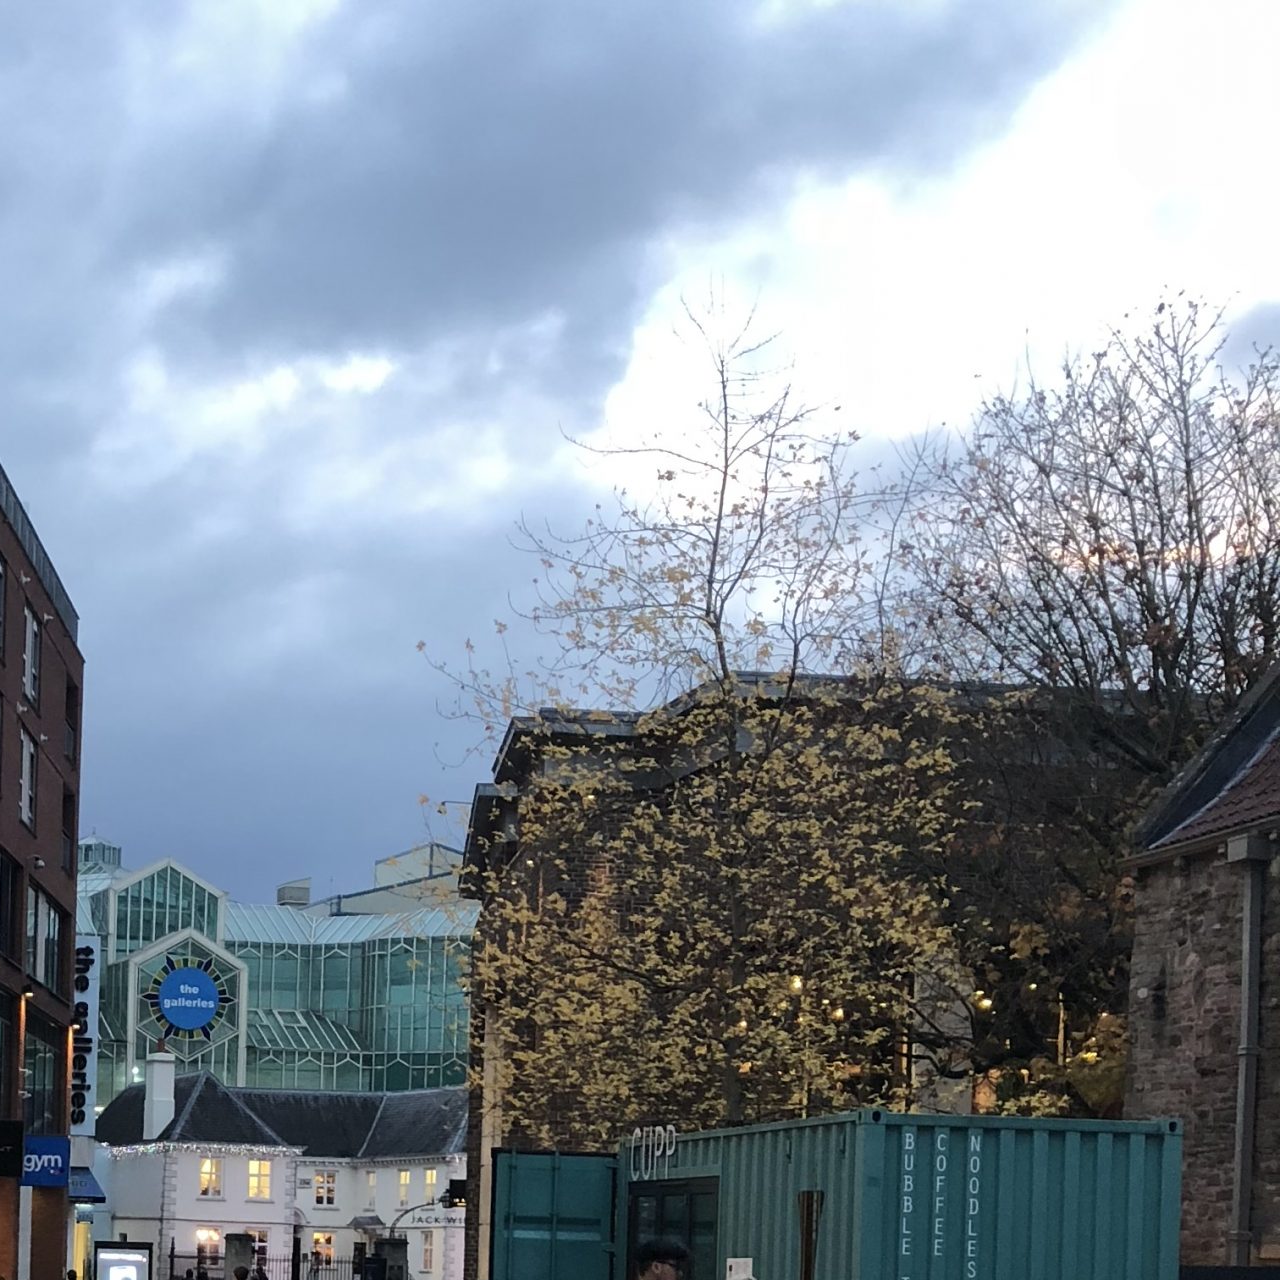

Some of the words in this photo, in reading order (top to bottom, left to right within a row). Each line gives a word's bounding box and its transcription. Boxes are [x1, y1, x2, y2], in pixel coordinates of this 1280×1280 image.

[74, 945, 95, 993] the
[179, 984, 200, 994] the
[163, 997, 215, 1009] galleries
[71, 1001, 93, 1126] galleries
[23, 1154, 62, 1172] gym
[630, 1124, 677, 1181] CUPP
[411, 1215, 441, 1225] JACK
[447, 1216, 465, 1225] WI
[901, 1132, 915, 1256] BUBBLE
[933, 1133, 948, 1256] COFFEE
[967, 1134, 981, 1279] NOODLES
